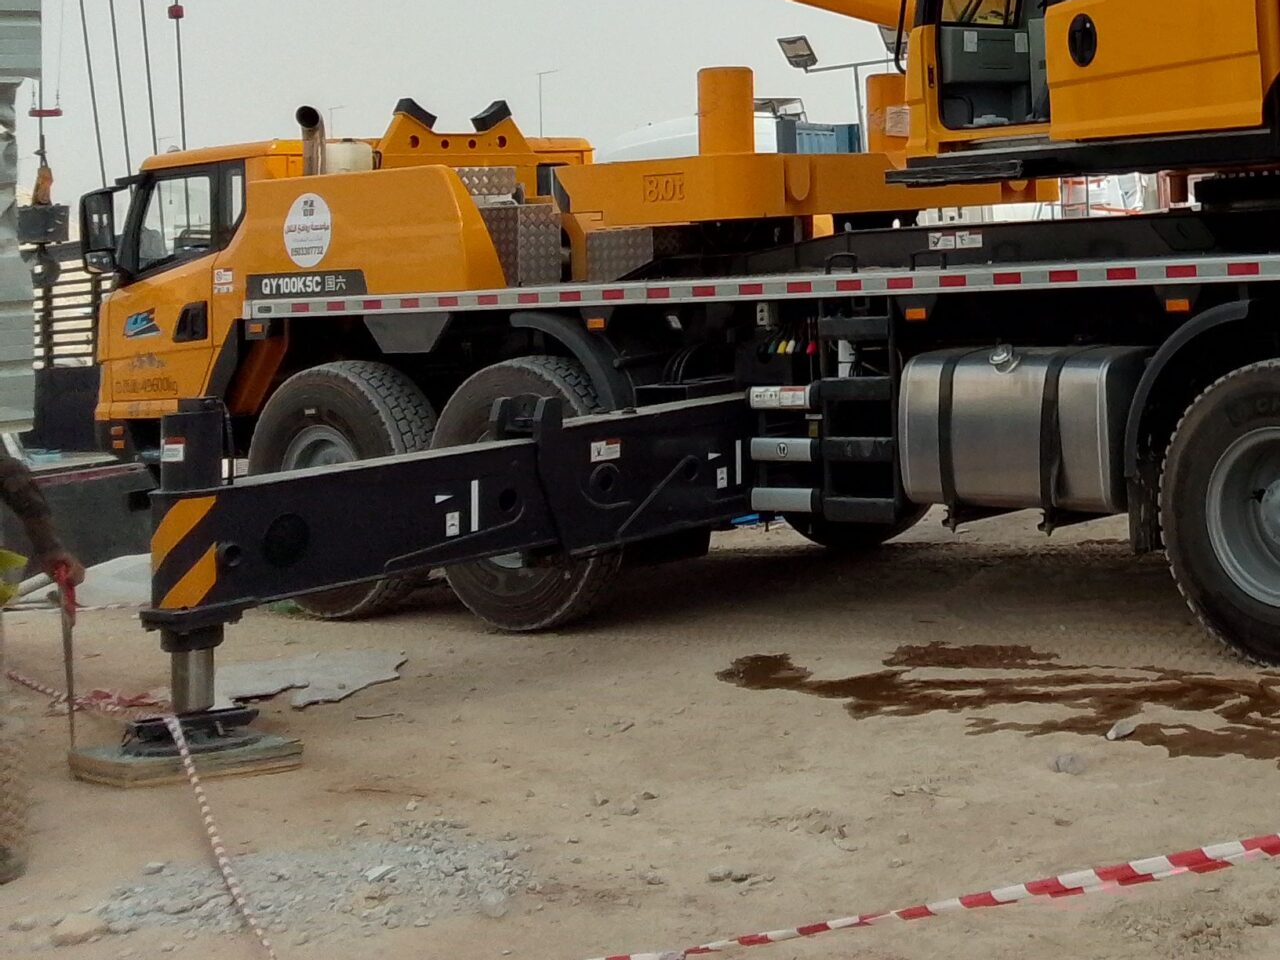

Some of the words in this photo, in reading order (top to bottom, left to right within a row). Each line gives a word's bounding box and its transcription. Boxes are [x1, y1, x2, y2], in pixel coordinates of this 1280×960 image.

[646, 176, 687, 203] 8.0t
[261, 276, 322, 295] QY100K5C
[324, 274, 347, 292] 国六
